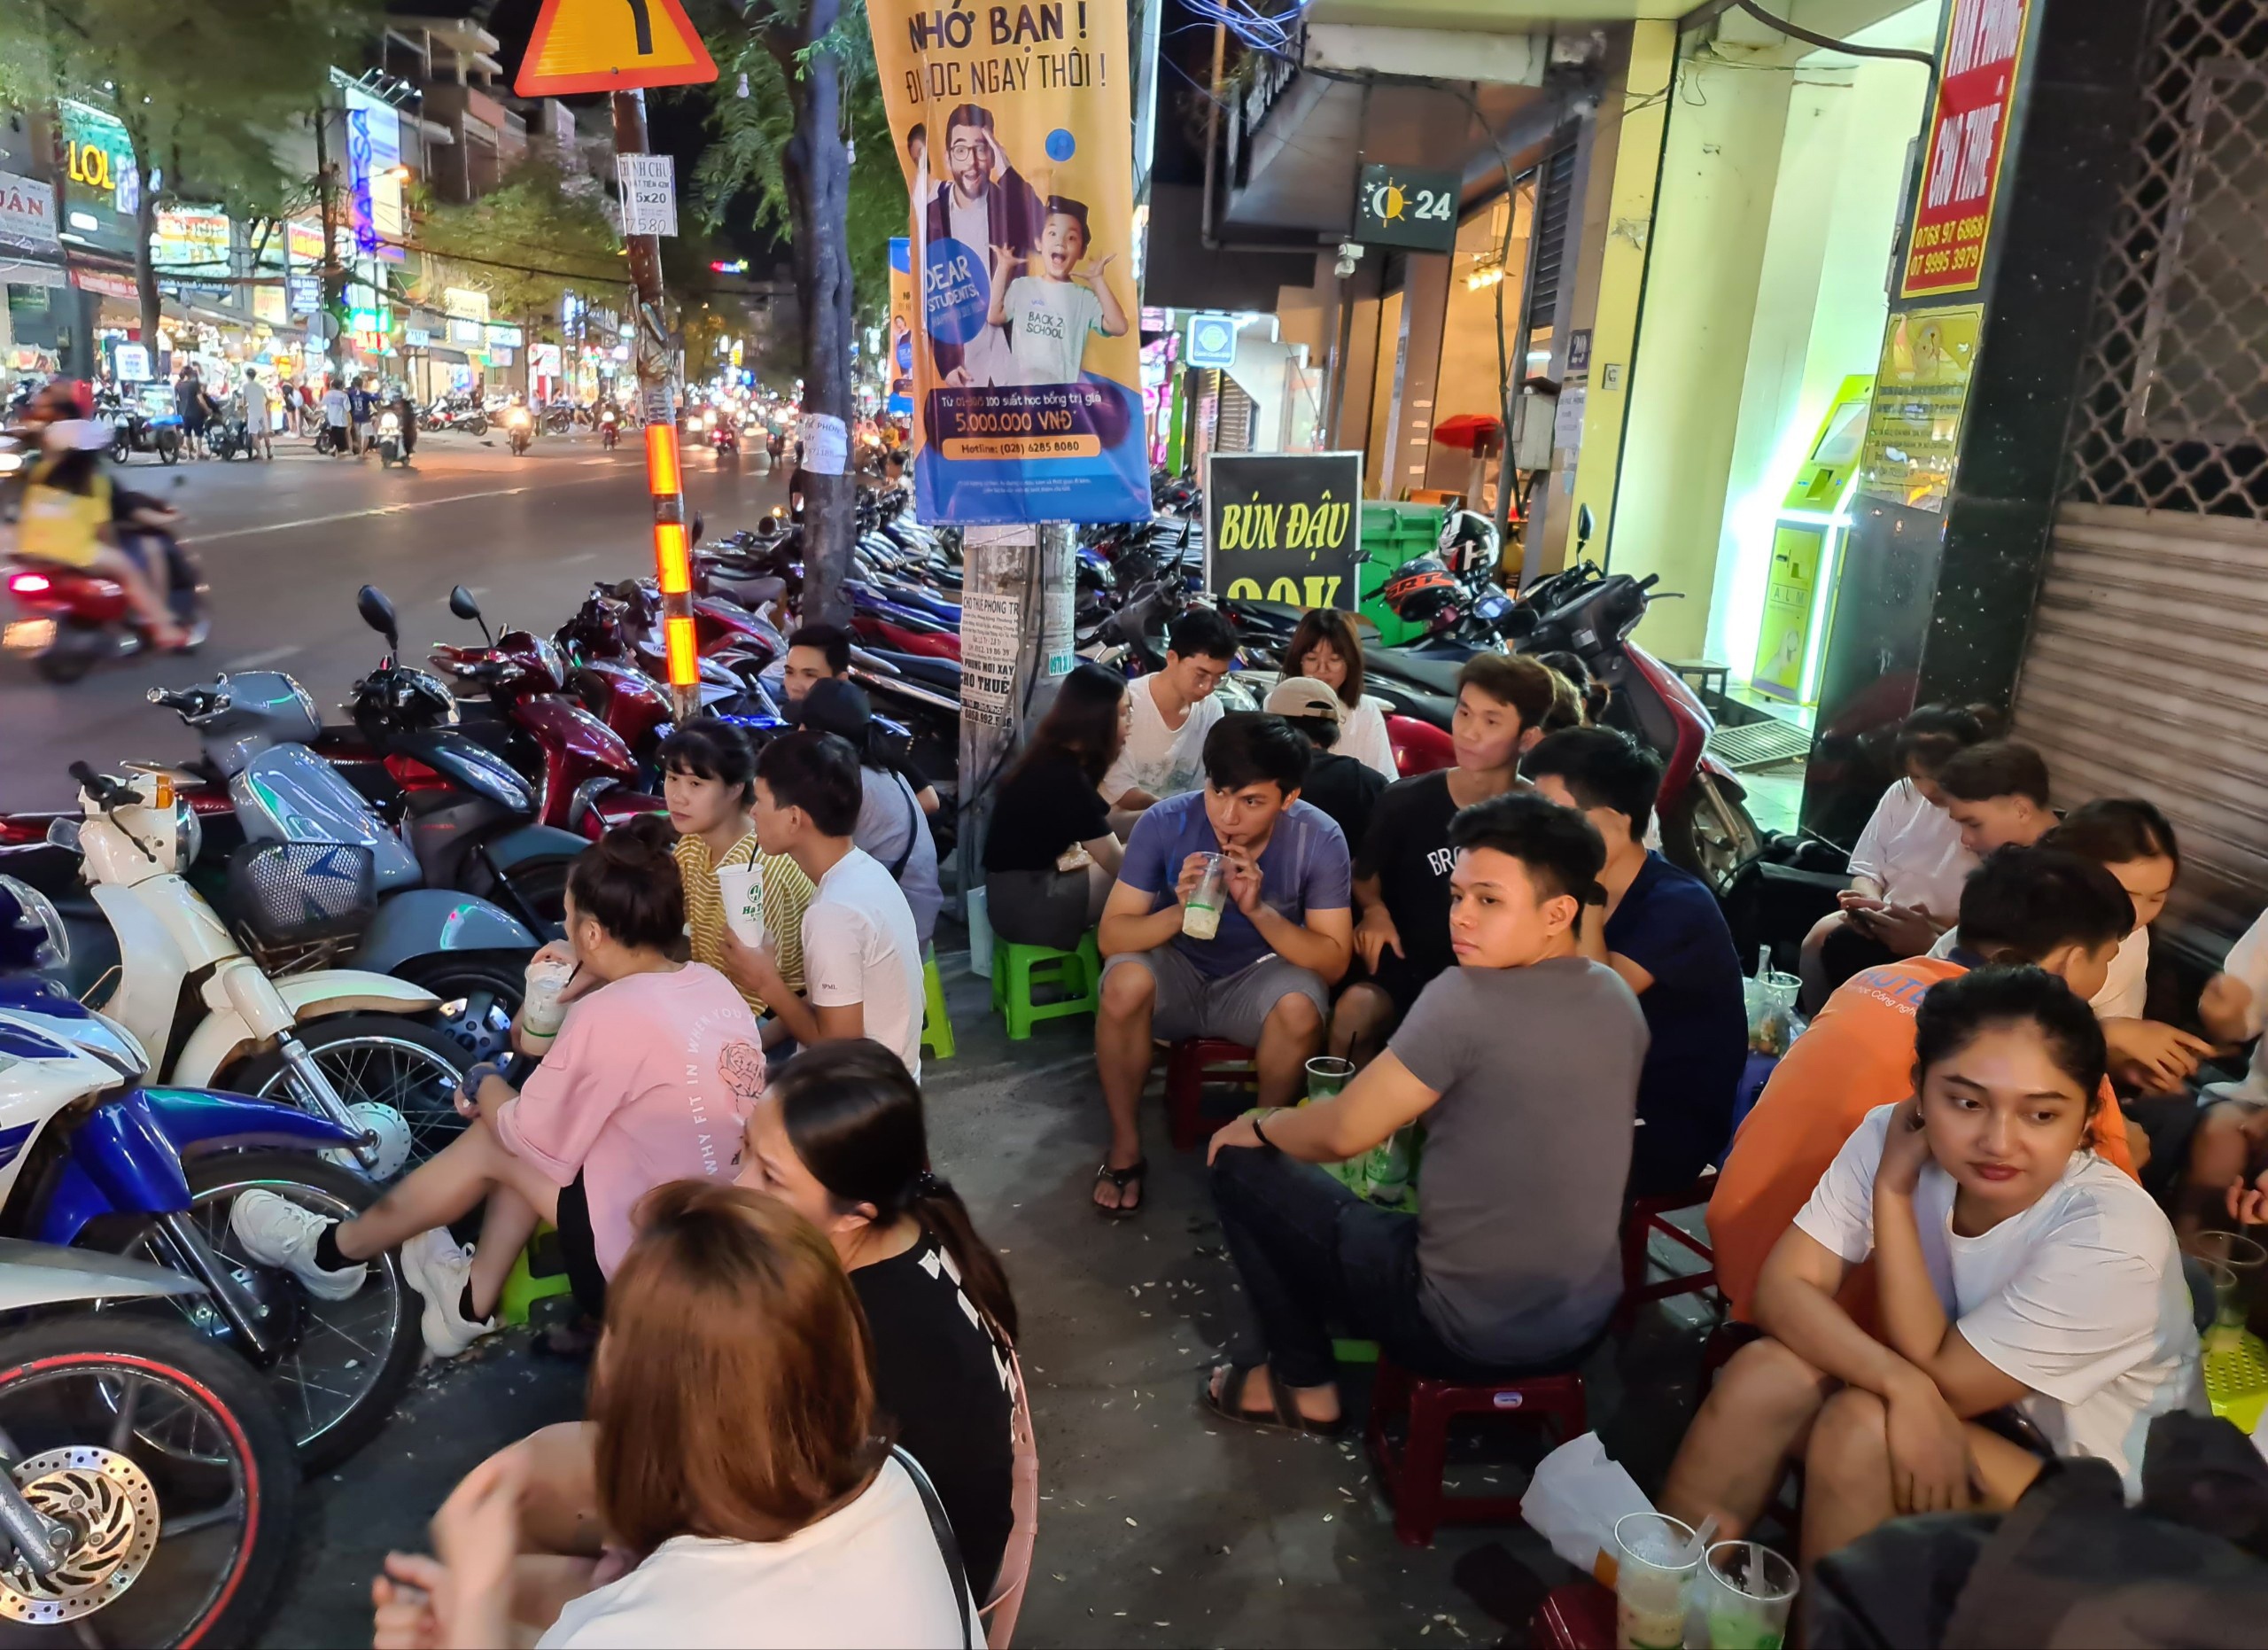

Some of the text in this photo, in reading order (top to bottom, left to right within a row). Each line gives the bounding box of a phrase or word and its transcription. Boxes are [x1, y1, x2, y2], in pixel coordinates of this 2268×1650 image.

[908, 0, 1087, 53] NHỚ BẠN !
[971, 56, 1029, 95] NGAY
[1037, 46, 1091, 89] THÔI
[69, 140, 115, 190] LOL
[1415, 190, 1451, 221] 24
[1909, 254, 1924, 276] 07
[1028, 311, 1064, 328] BACK 2
[1026, 323, 1064, 339] SCHOOL
[955, 411, 1032, 432] 5.000.000
[961, 443, 998, 455] Hotline:
[1028, 441, 1052, 453] 6285
[1054, 440, 1080, 452] 8080
[1219, 489, 1351, 562] BÚN ĐẬU
[977, 676, 1010, 695] THUÊ
[1871, 990, 1896, 1007] Công
[687, 1008, 742, 1176] WHY FIT IN WHEN YOU
